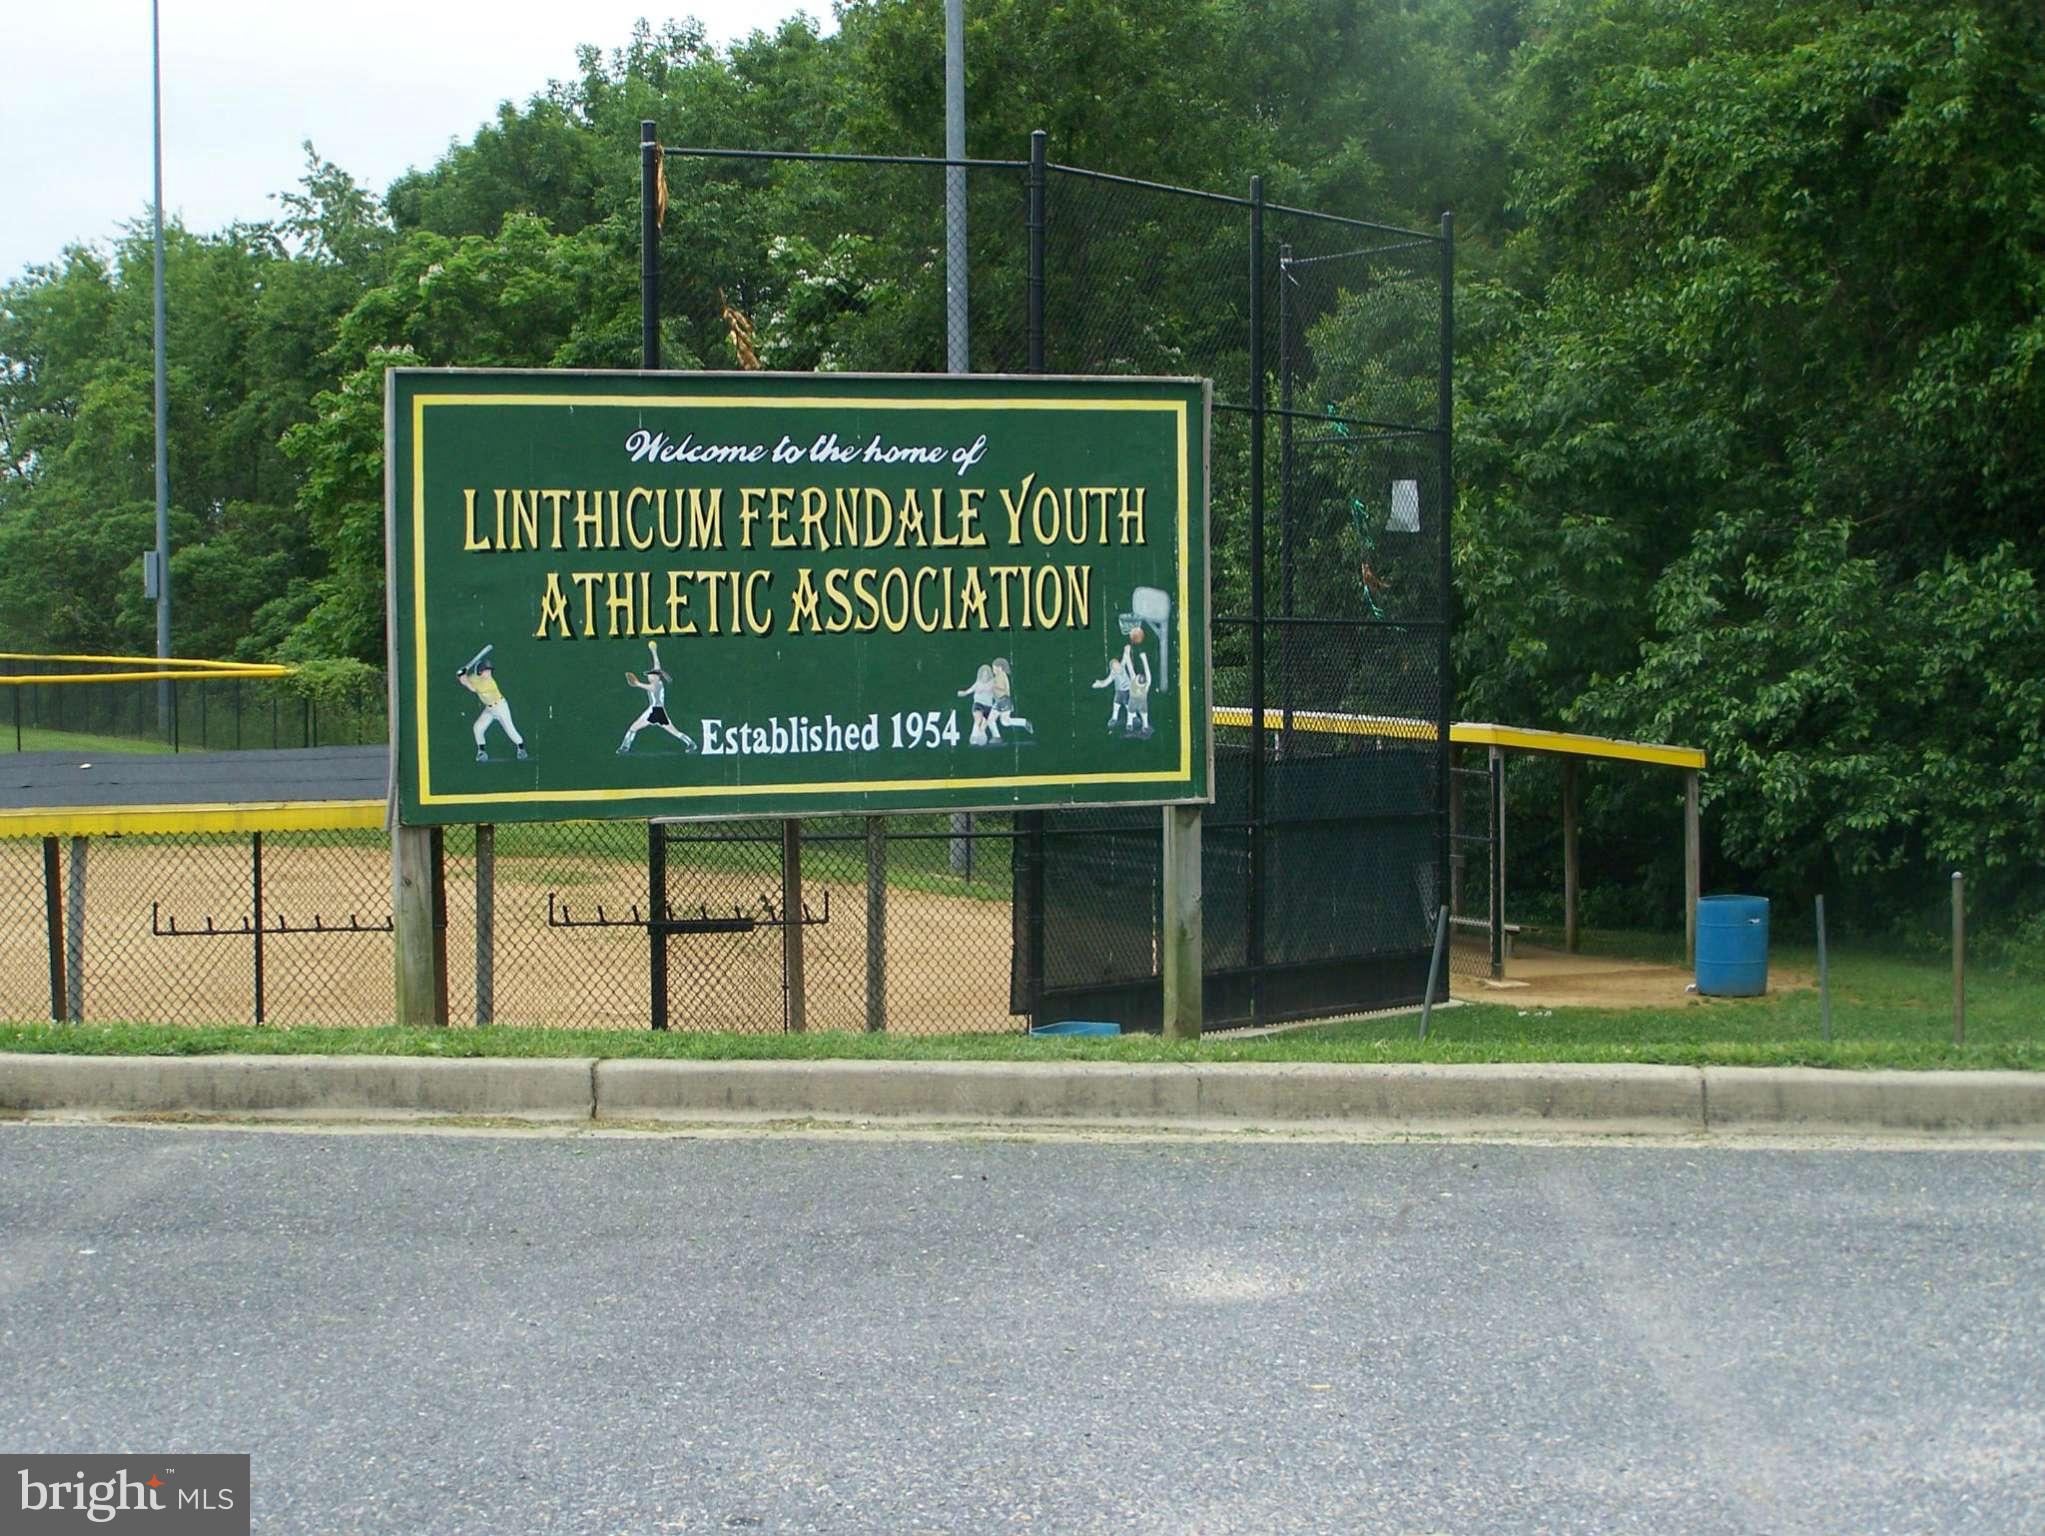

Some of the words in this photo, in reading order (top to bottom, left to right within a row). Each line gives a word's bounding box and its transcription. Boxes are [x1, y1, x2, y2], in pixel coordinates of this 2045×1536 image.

[625, 429, 768, 464] Welcome
[771, 435, 807, 464] to
[809, 433, 861, 464] the
[862, 434, 949, 464] home
[951, 433, 988, 476] of
[463, 486, 724, 552] LINTHICUM
[739, 486, 988, 551] FERNDALE
[1000, 472, 1147, 547] YOUTH
[534, 570, 773, 638] ATHLETIC
[787, 564, 1091, 633] ASSOCIATION
[700, 713, 880, 756] Established
[890, 709, 961, 750] 1954
